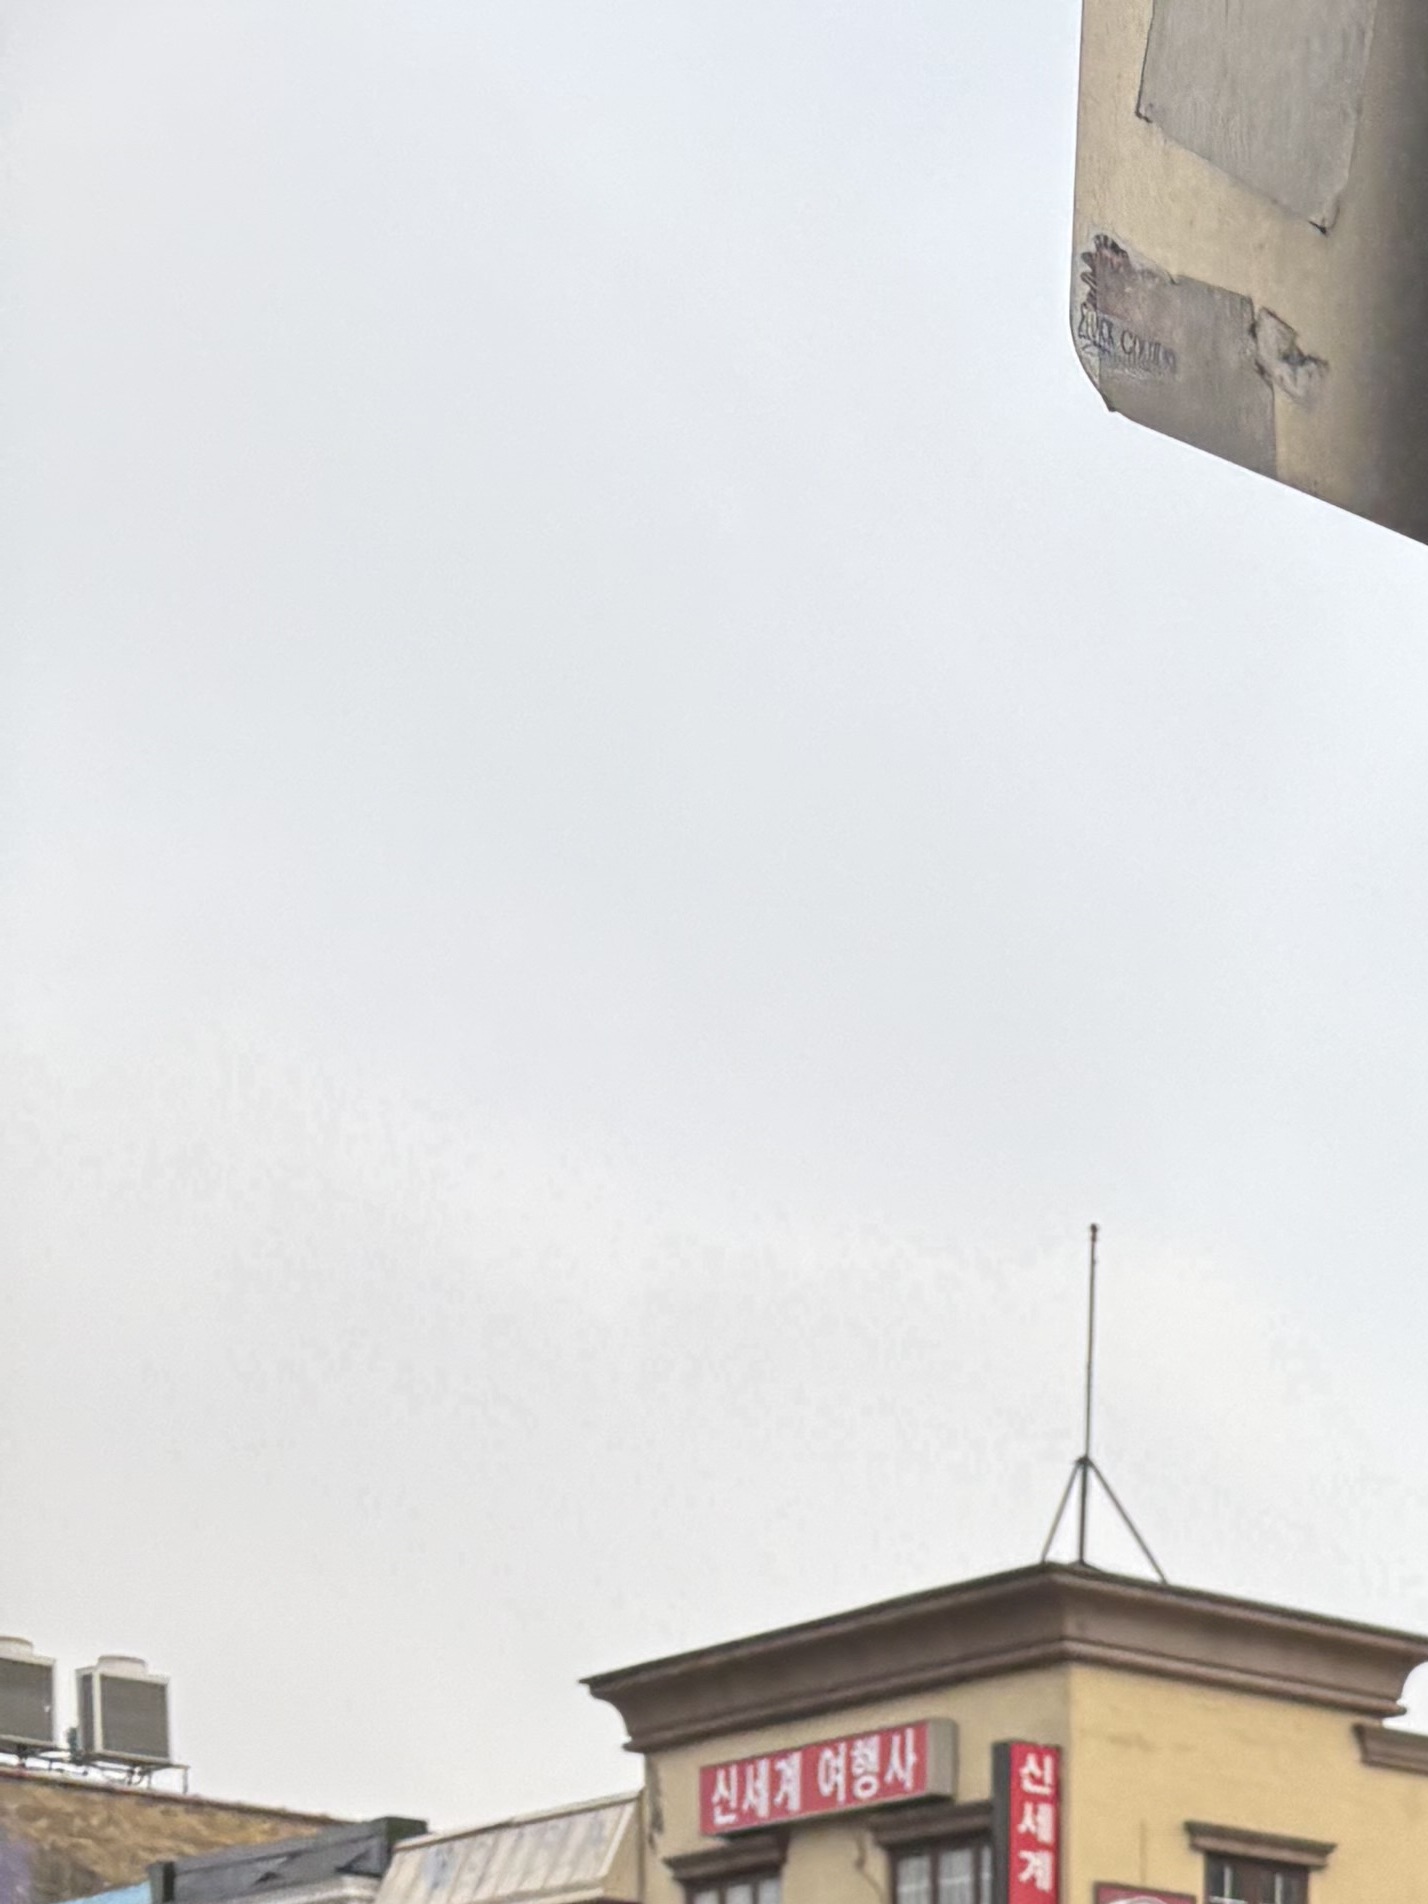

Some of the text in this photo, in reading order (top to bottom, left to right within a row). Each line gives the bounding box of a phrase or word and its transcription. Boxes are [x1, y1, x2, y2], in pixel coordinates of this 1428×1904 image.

[712, 1727, 917, 1825] 신세계 여행사
[1017, 1752, 1055, 1893] 신세계
